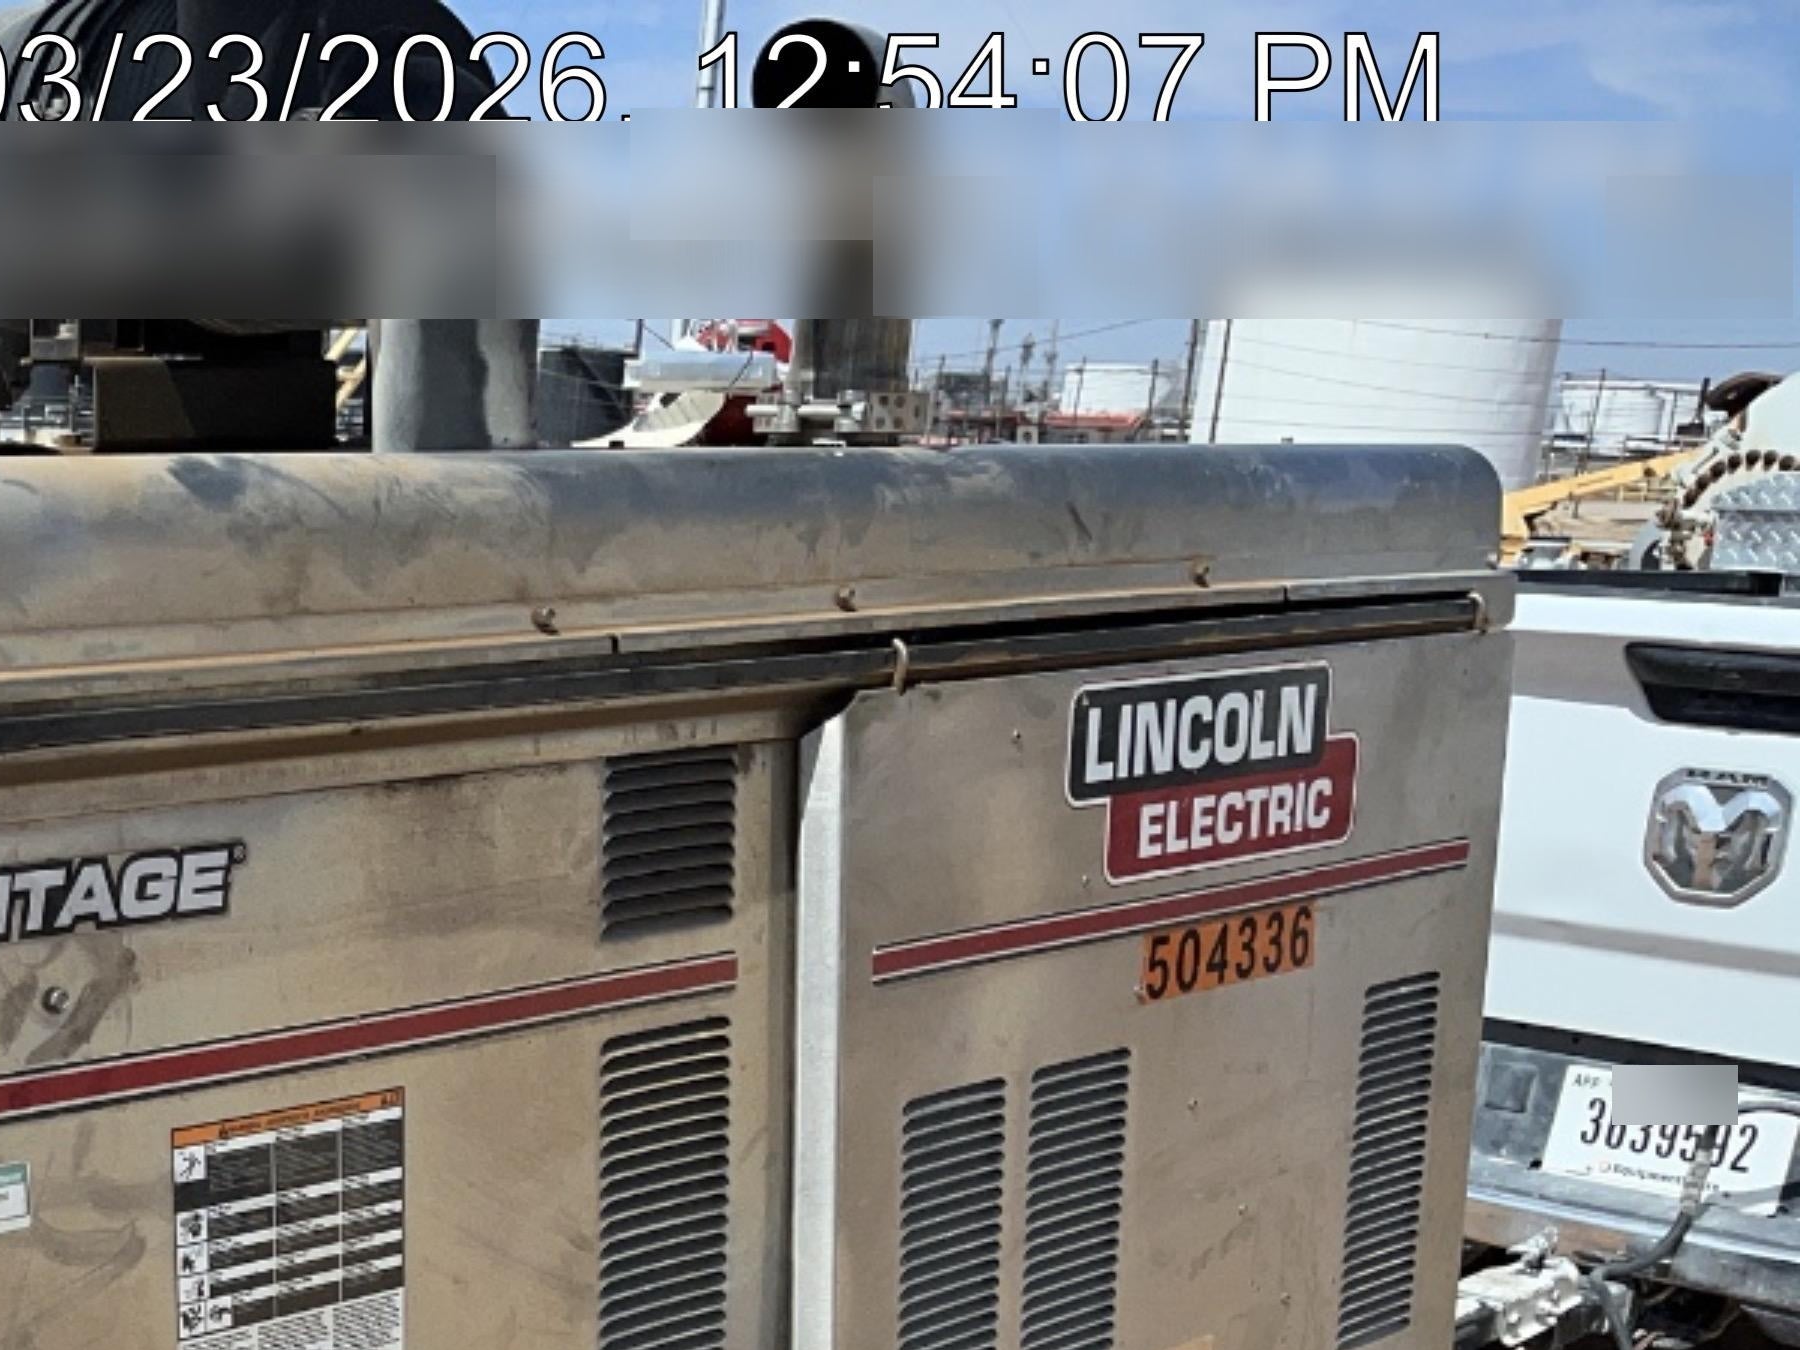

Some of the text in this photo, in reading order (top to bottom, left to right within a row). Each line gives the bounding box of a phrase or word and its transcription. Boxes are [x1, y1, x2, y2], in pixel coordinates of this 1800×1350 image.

[1083, 683, 1318, 785] LINCOLN
[1136, 776, 1333, 859] ELECTRIC
[1144, 905, 1314, 1000] 504336
